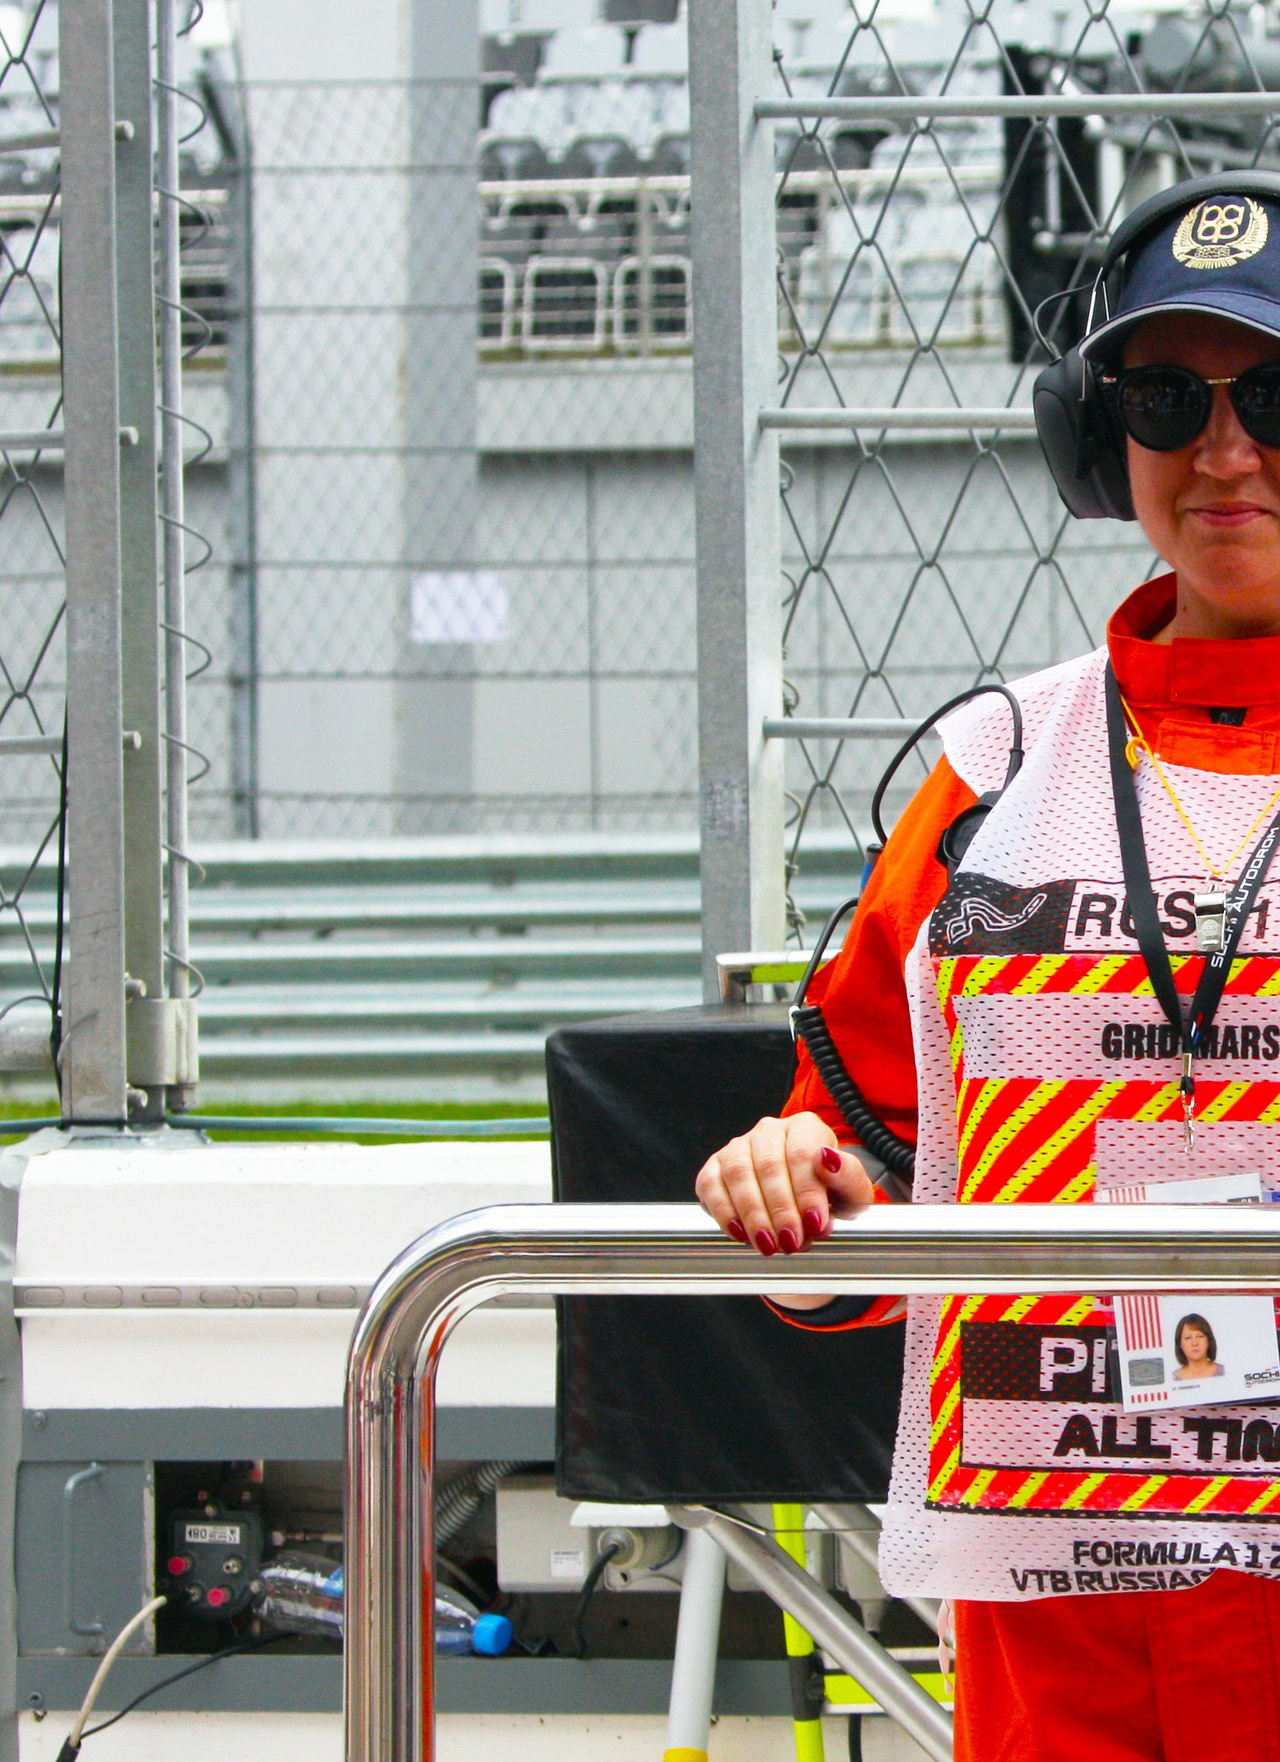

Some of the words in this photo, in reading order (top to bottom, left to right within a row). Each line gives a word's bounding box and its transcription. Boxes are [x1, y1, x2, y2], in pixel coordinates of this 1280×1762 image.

[1232, 827, 1280, 912] AUTODROM
[1101, 1023, 1179, 1059] GRID
[1039, 1337, 1118, 1393] PI
[1053, 1414, 1171, 1459] ALL
[1073, 1540, 1238, 1567] FORMULA
[1244, 1544, 1263, 1568] 1
[1010, 1567, 1072, 1593] VTB
